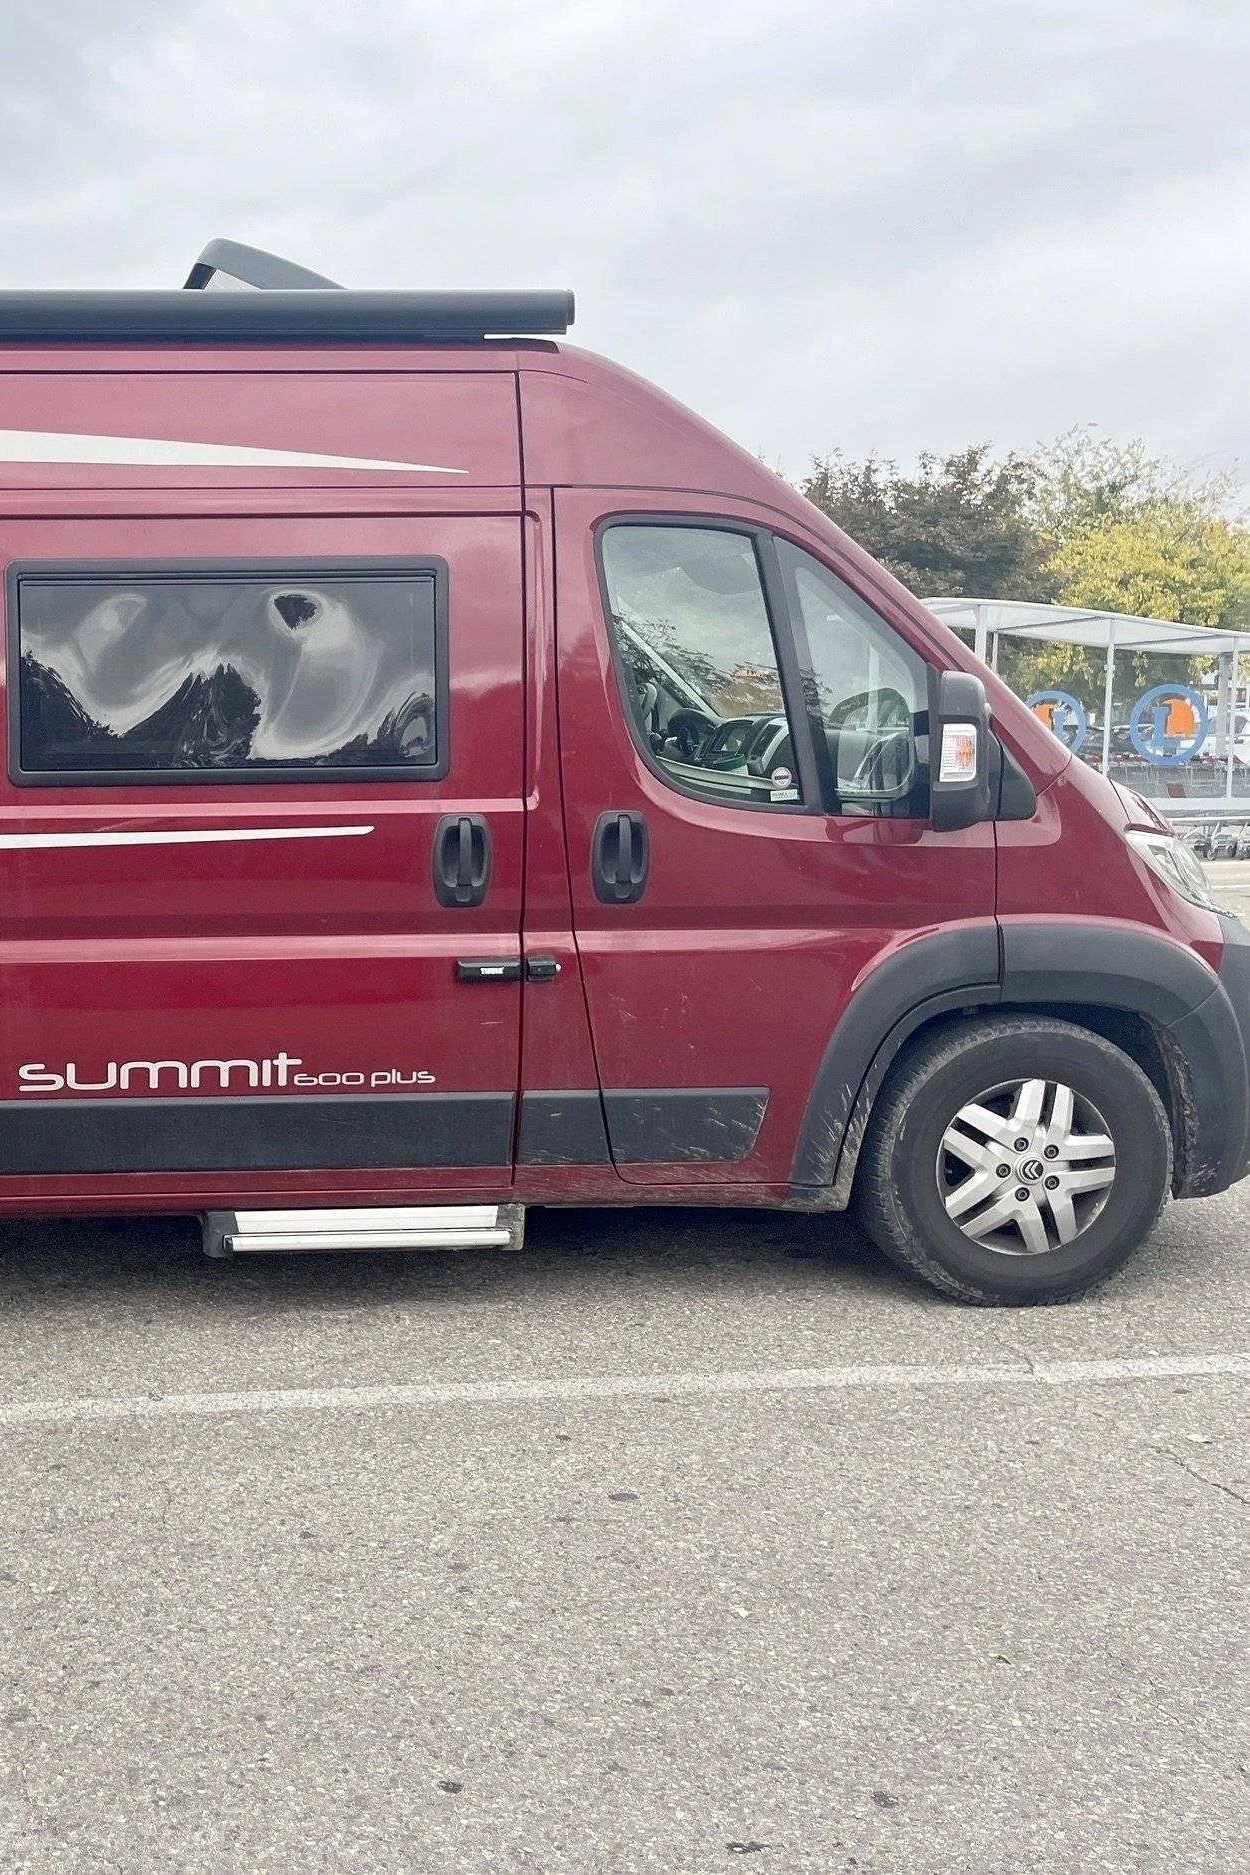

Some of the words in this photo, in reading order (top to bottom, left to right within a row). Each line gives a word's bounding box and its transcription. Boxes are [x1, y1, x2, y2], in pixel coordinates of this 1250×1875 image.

[18, 1052, 303, 1092] summit
[293, 1072, 365, 1087] 600
[370, 1068, 437, 1088] plus
